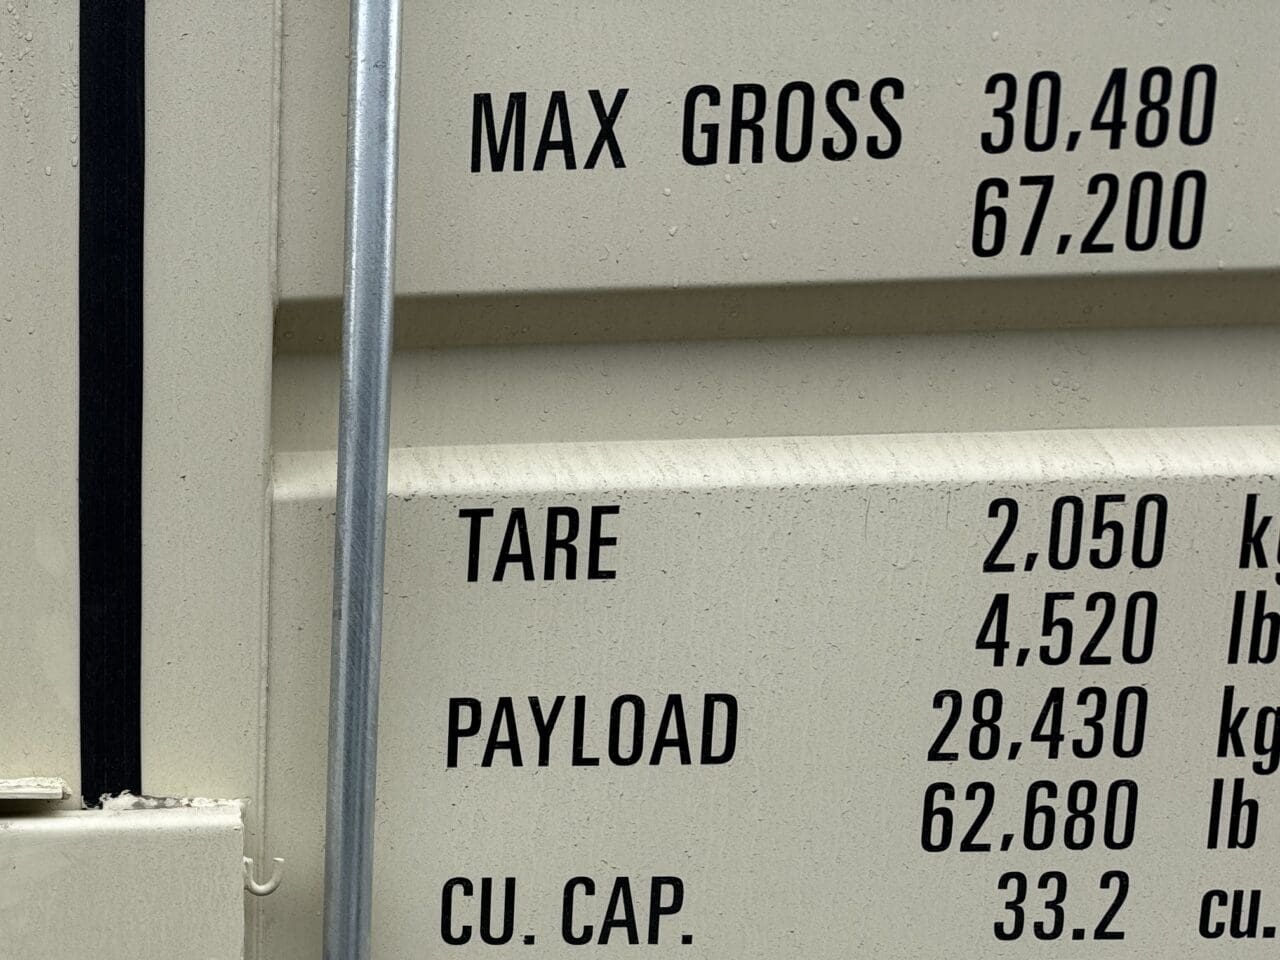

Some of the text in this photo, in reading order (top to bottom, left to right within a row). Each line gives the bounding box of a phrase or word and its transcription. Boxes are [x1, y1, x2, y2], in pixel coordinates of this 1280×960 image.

[471, 64, 1216, 172] MAX GROSS 30,480
[973, 170, 1206, 257] 67,200
[459, 494, 1280, 585] TARE 2,050 k
[976, 590, 1280, 666] 4,520 lb
[447, 686, 1280, 775] PAYLOAD 28,430 kg
[922, 778, 1258, 852] 62,680 lb
[441, 877, 534, 945] CU.
[562, 877, 692, 945] CAP.
[994, 871, 1129, 940] 33.2
